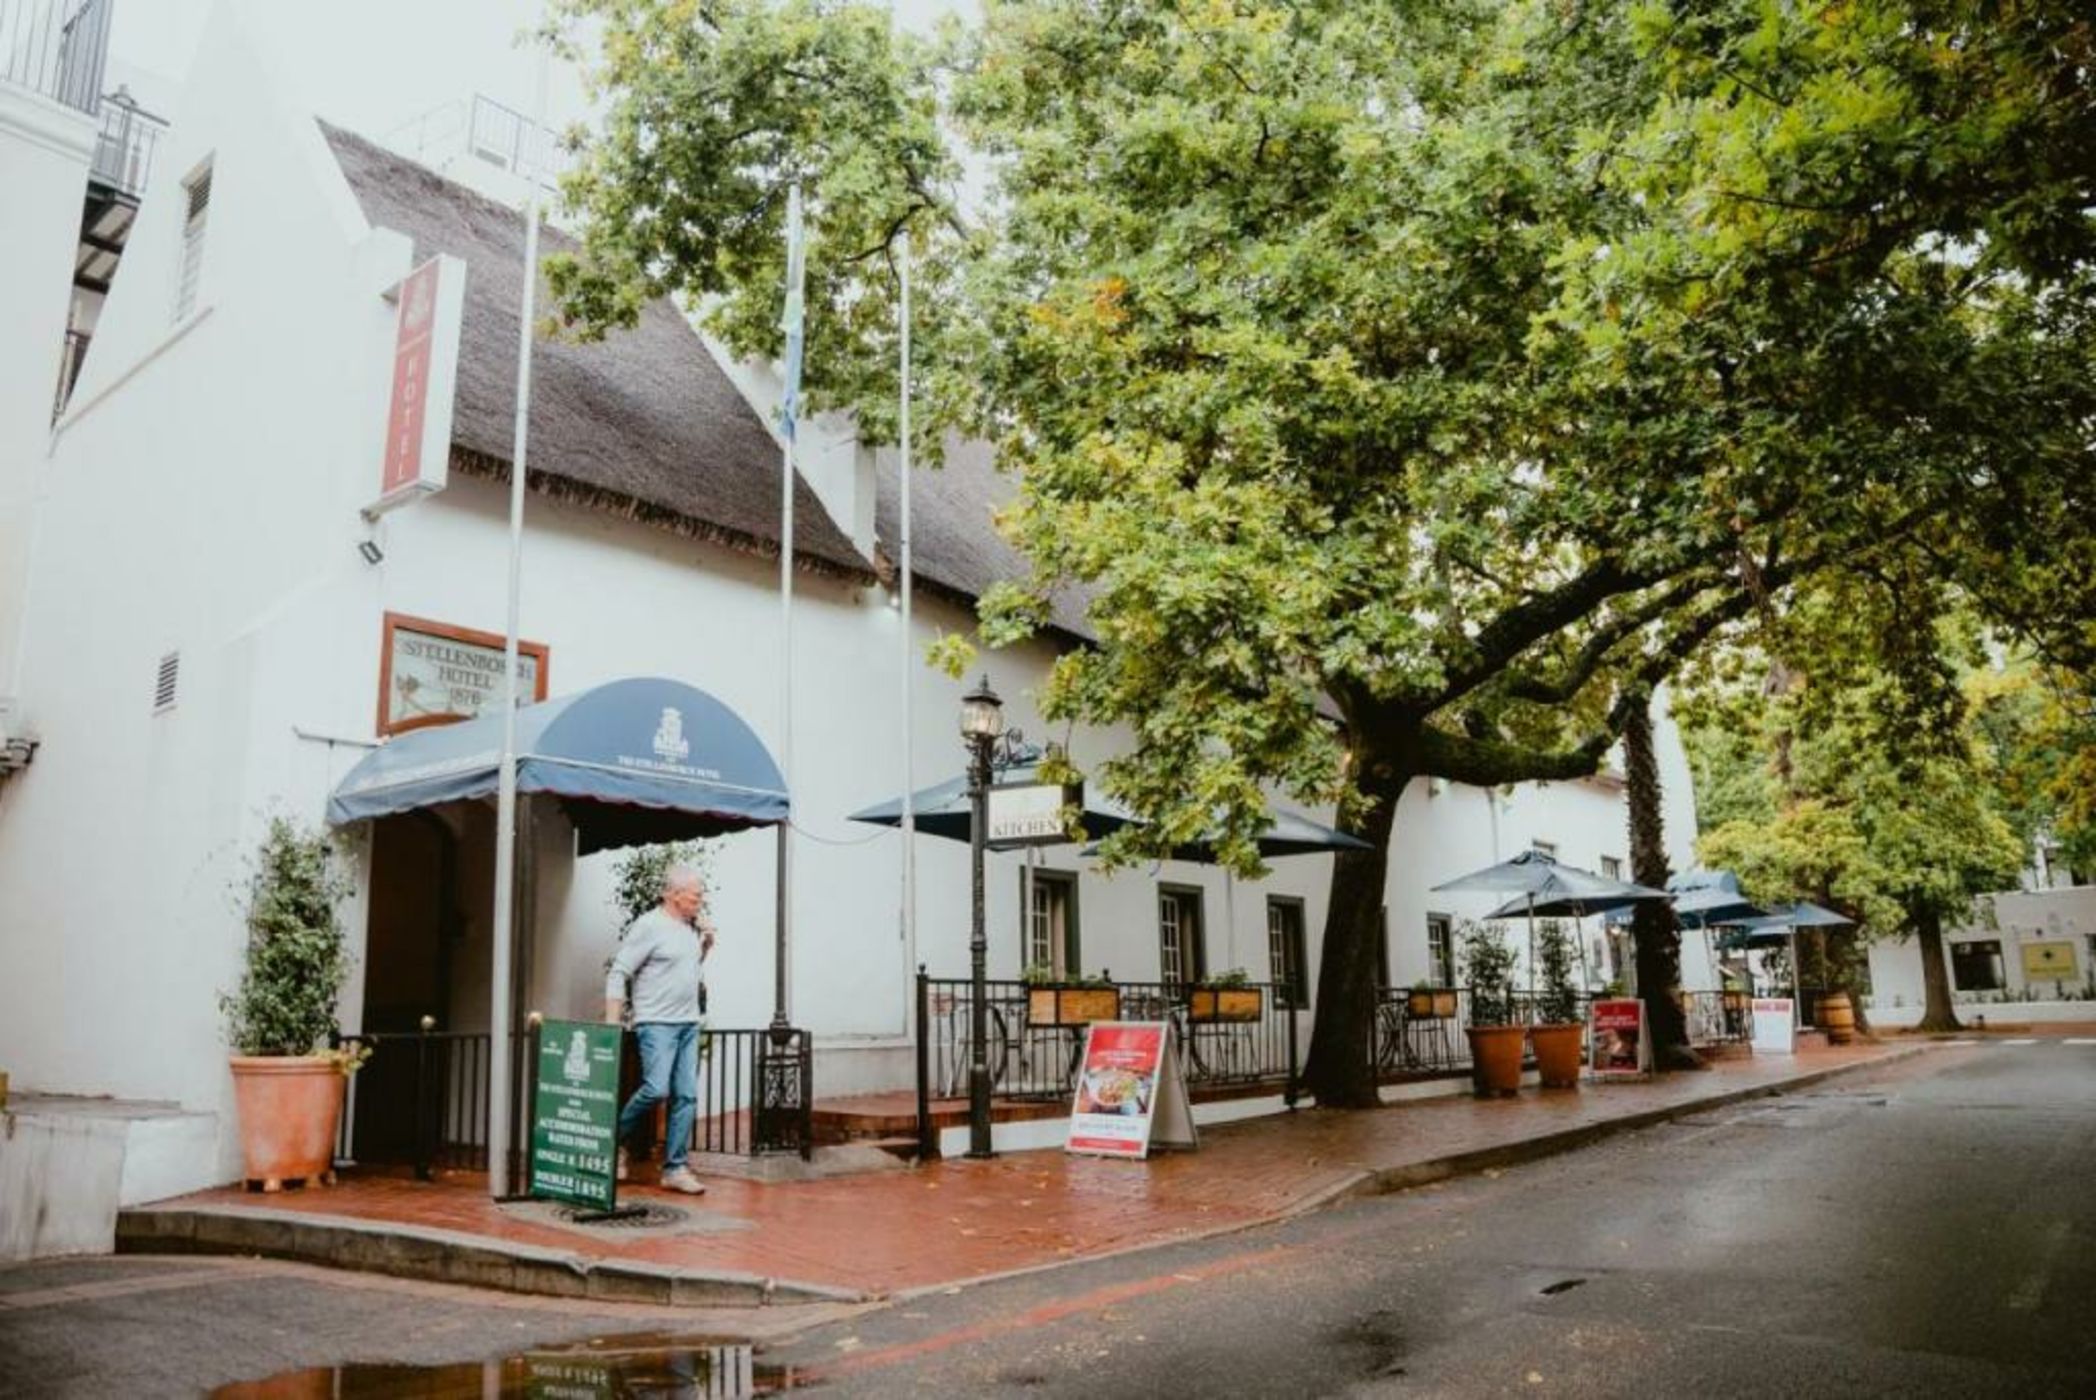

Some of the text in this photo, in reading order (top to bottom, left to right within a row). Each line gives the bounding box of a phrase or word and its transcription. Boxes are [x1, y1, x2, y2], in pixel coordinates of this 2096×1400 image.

[439, 665, 494, 691] HOTEL
[450, 687, 482, 705] 1876
[993, 818, 1059, 837] KITCHEN
